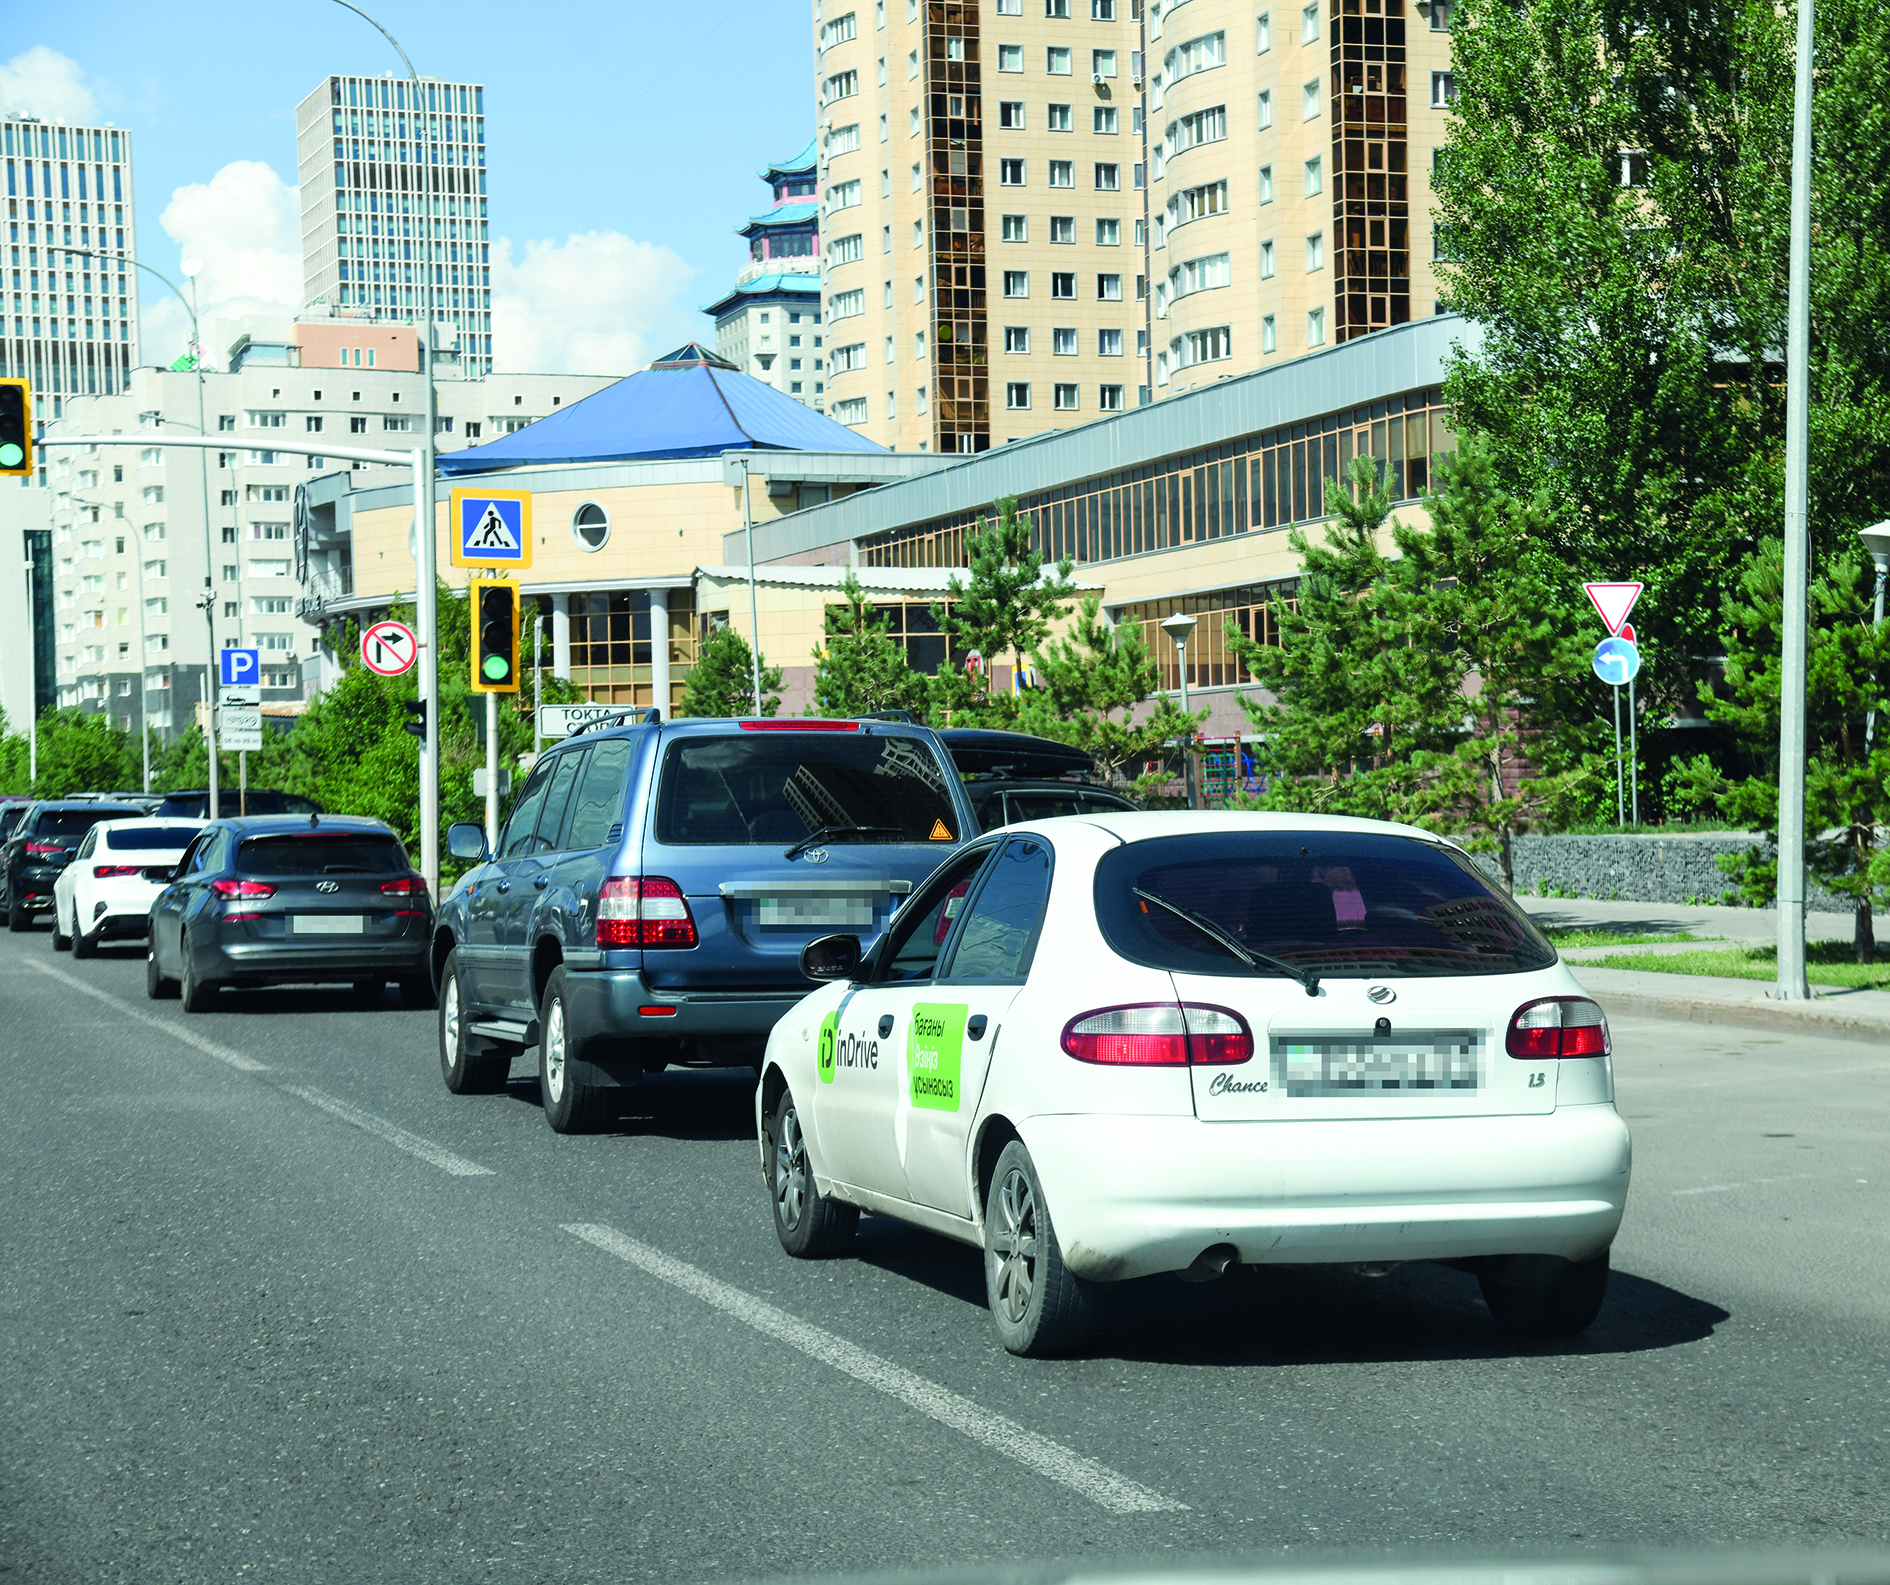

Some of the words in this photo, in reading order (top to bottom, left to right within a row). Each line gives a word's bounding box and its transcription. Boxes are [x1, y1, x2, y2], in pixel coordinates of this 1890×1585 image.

[230, 652, 254, 682] P
[915, 1012, 946, 1037] бағаны
[836, 1029, 878, 1070] inDrive
[1209, 1072, 1268, 1097] Chance
